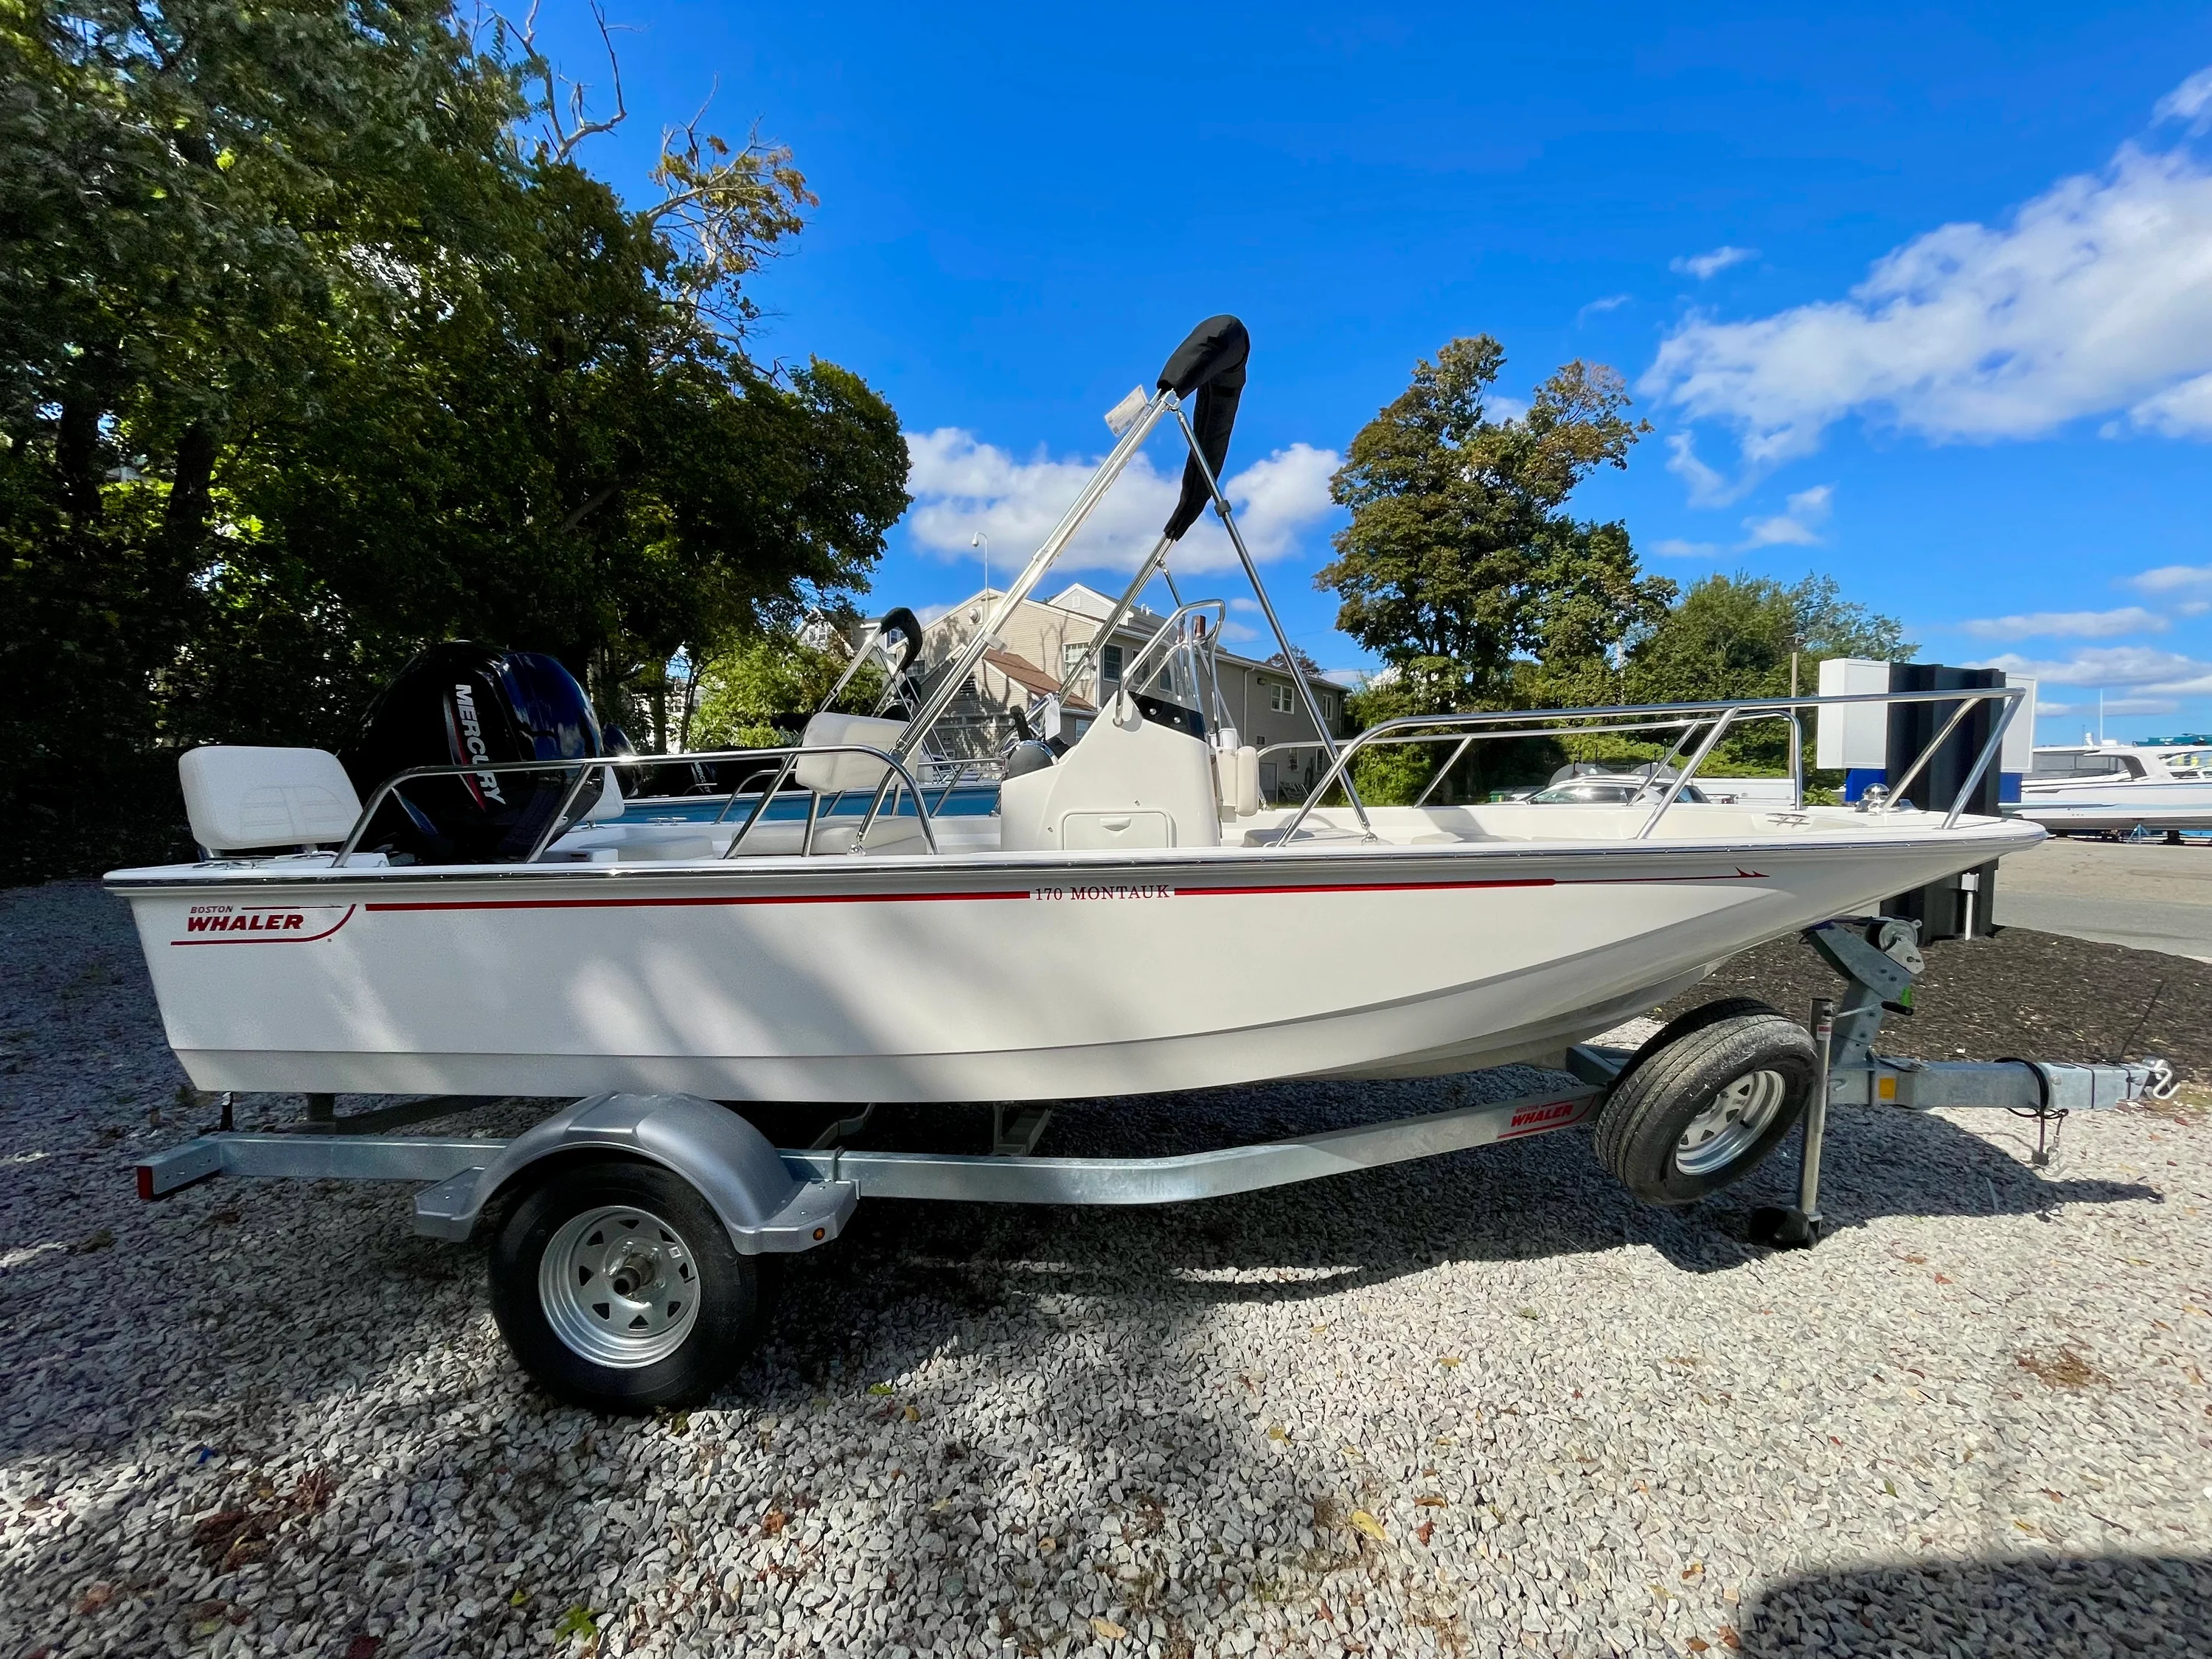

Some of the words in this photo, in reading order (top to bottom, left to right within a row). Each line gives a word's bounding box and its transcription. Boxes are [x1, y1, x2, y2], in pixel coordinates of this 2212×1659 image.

[1035, 887, 1062, 900] 170
[1069, 884, 1169, 900] MONTAUK
[189, 905, 233, 914] BOSTON
[187, 914, 304, 932] WHALER
[1511, 1103, 1574, 1127] WHALER
